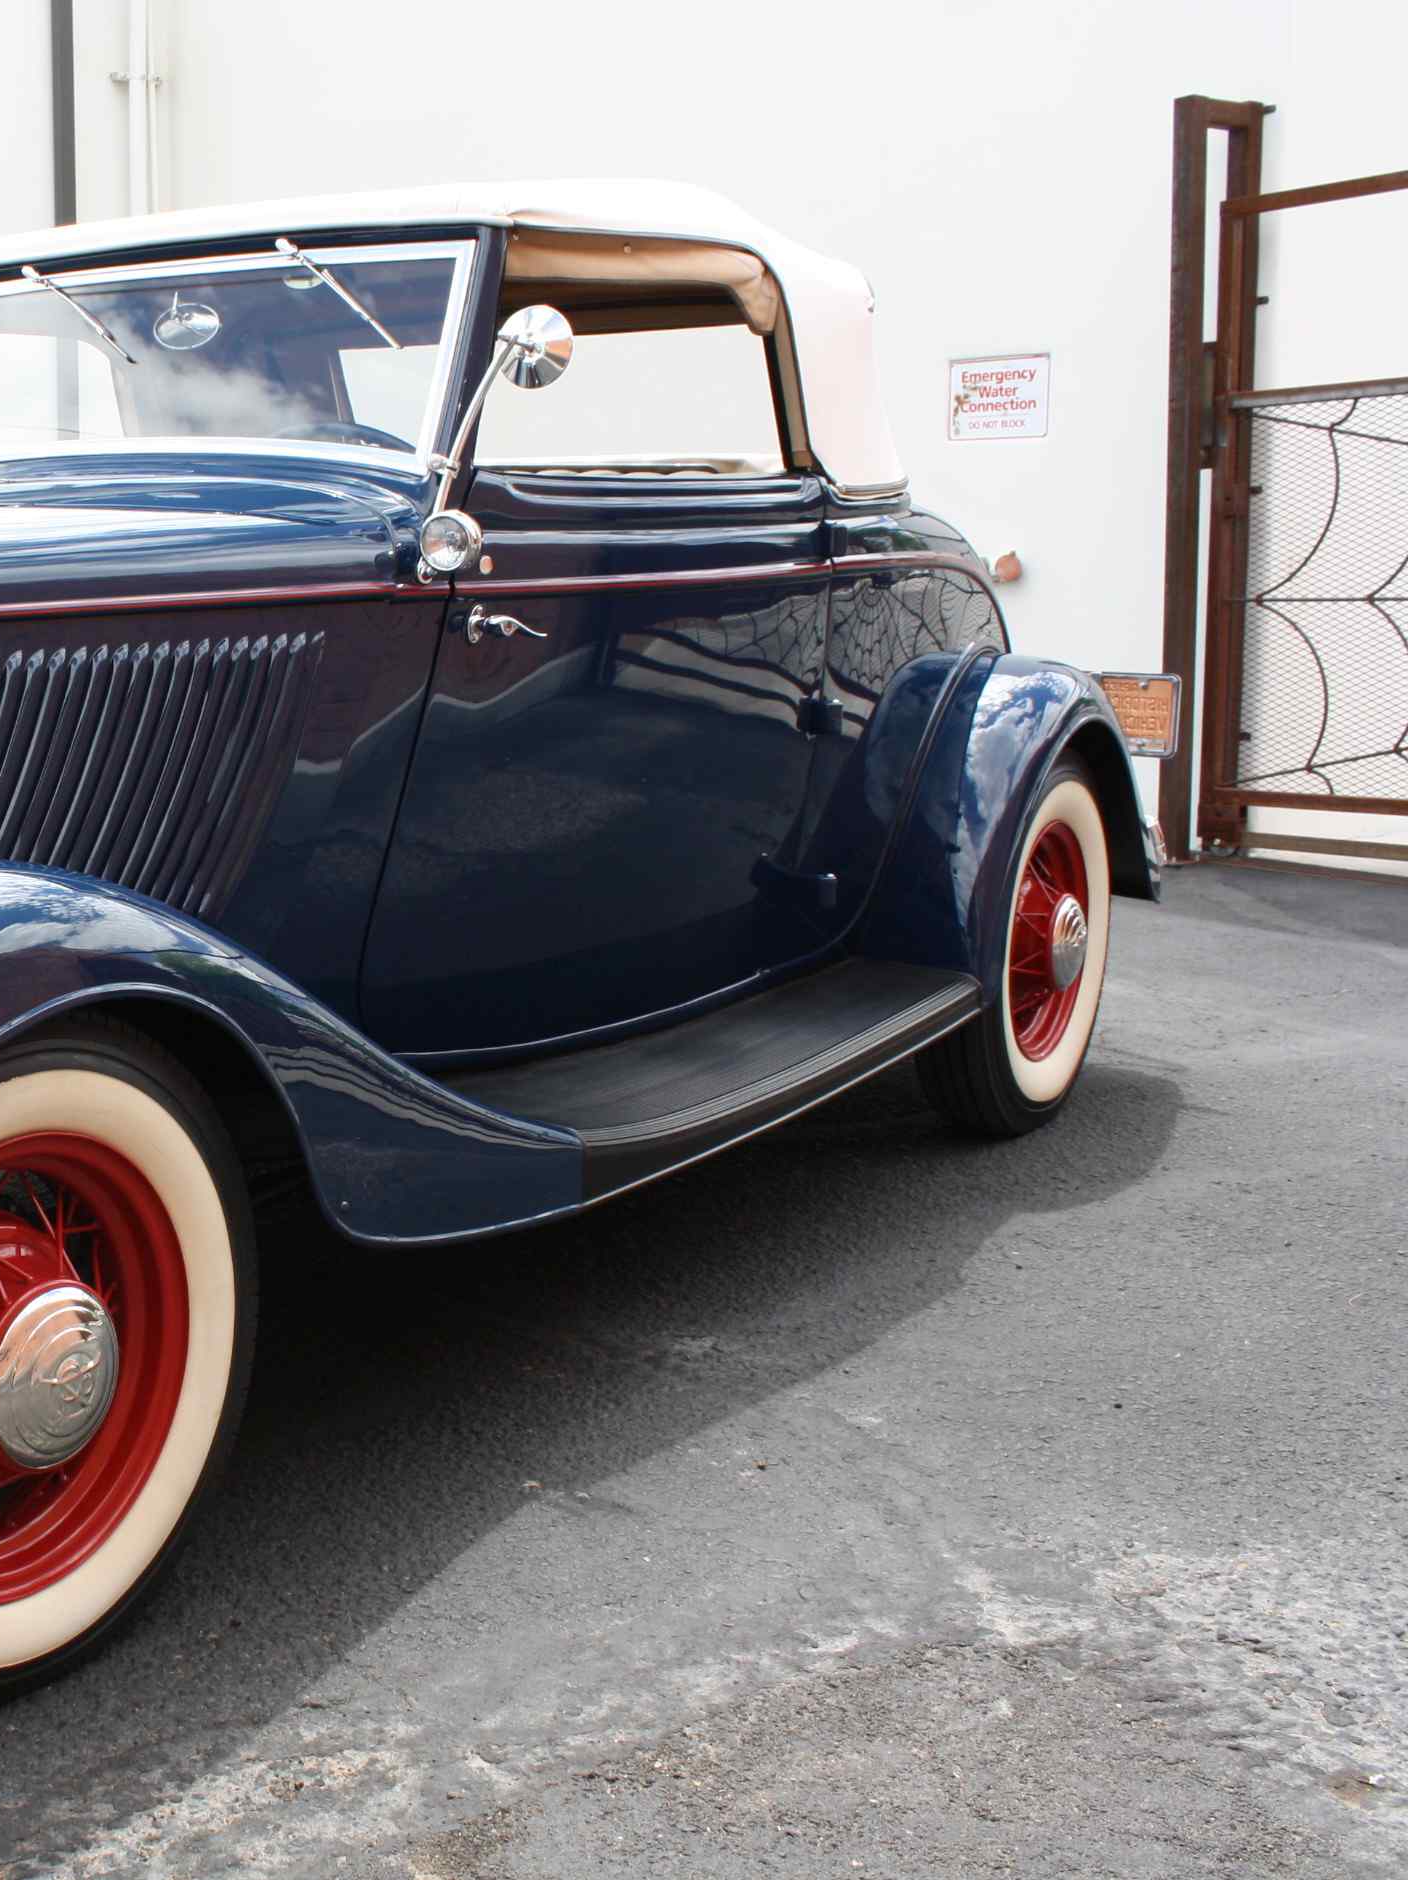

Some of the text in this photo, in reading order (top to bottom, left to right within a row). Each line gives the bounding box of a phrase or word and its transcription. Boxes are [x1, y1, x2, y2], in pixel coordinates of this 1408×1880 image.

[961, 368, 1037, 384] Emergency
[978, 385, 1018, 398] Water
[960, 399, 1038, 413] Connection
[968, 419, 1025, 430] DO NOT BLOCK
